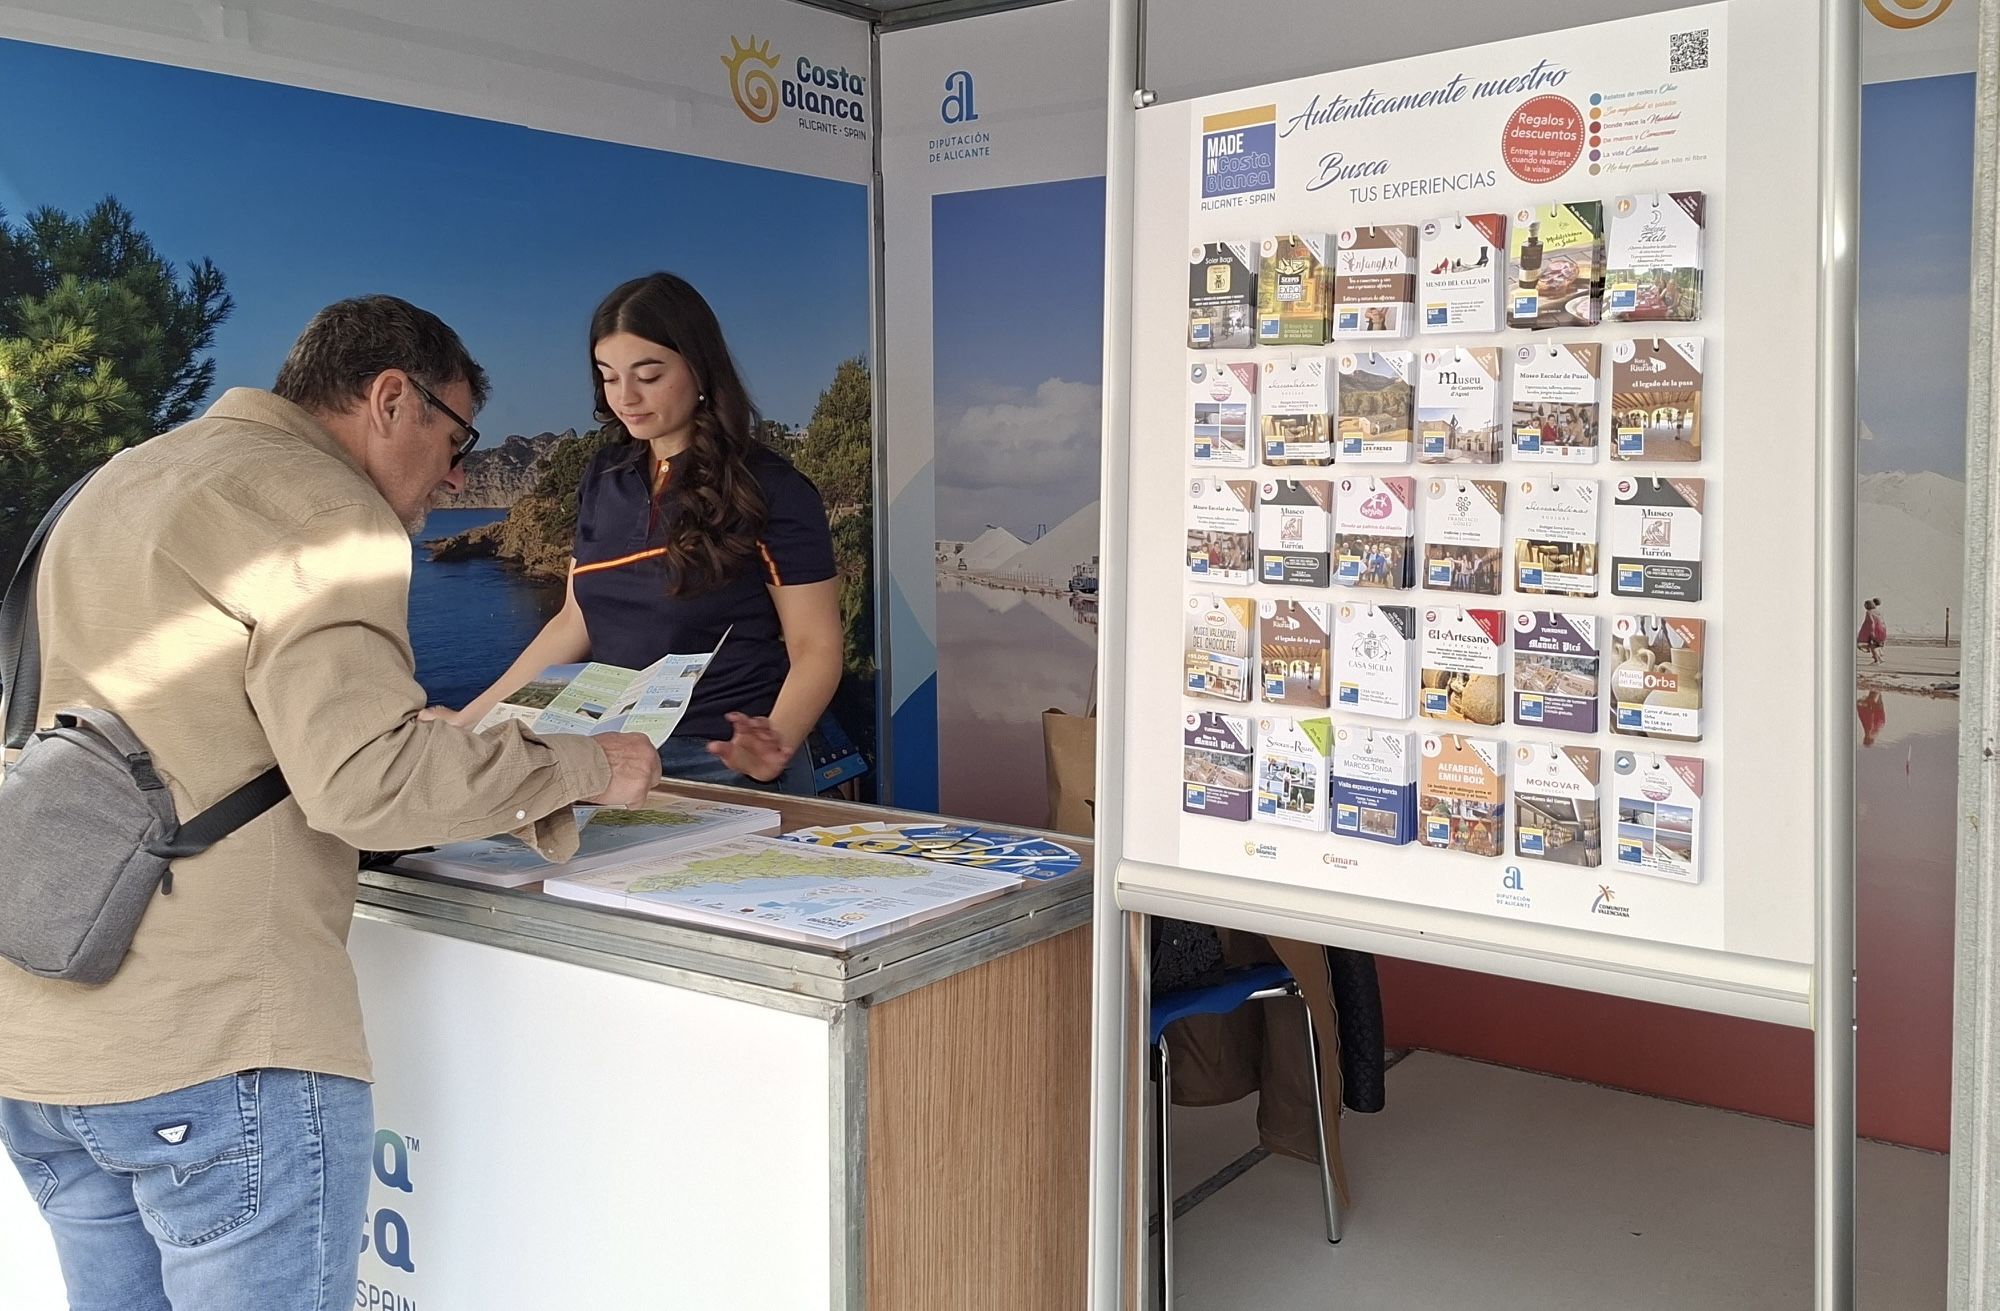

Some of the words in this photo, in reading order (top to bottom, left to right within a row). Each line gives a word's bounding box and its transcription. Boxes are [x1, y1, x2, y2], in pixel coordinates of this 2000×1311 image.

[796, 57, 864, 97] Costa
[1473, 58, 1572, 99] nuestro
[781, 79, 864, 123] Blanca
[1518, 112, 1565, 128] Regalos
[1568, 116, 1575, 127] y
[799, 118, 838, 136] ALICANTE
[844, 127, 866, 141] SPAIN
[1510, 127, 1577, 142] descuentos
[929, 132, 990, 150] DIPUTACIÓN
[1207, 133, 1244, 158] MADE
[930, 152, 941, 163] DE
[944, 147, 990, 162] ALICANTE
[1510, 147, 1538, 157] Entrega
[1547, 150, 1571, 159] tarjeta
[1207, 157, 1218, 176] IN
[1219, 151, 1271, 171] Costa
[1539, 158, 1567, 166] realices
[1306, 152, 1392, 192] Busca
[1206, 170, 1271, 194] Blanca
[1350, 186, 1378, 205] TUS
[1383, 170, 1497, 201] EXPERIENCIAS
[1201, 196, 1242, 211] ALICANTE
[1249, 192, 1276, 205] SPAIN
[1461, 278, 1490, 286] CALZADO
[1438, 371, 1480, 385] Museu
[1640, 380, 1660, 388] legado
[1281, 508, 1304, 516] Museo
[1641, 509, 1673, 518] Museo
[1280, 542, 1303, 550] Turrón
[1640, 547, 1672, 557] Turrón
[1429, 629, 1440, 640] El
[1441, 630, 1489, 644] Artesano
[1349, 660, 1367, 669] CASA
[1368, 664, 1393, 672] SICILIA
[1645, 675, 1676, 688] Orba
[1352, 754, 1384, 765] Chocolates
[1344, 760, 1370, 771] MARCOS
[1372, 765, 1393, 774] TONDA
[1439, 763, 1484, 775] ALFARERÍA
[1439, 772, 1462, 782] EMILI
[1463, 774, 1485, 785] BOIX
[1526, 778, 1580, 791] MONOVAR
[1352, 784, 1377, 793] exposición
[1323, 853, 1358, 866] Cámara
[1496, 893, 1530, 903] DIPUTACIÓN
[1505, 900, 1530, 910] ALICANTE
[1598, 909, 1630, 919] VALENCIANA
